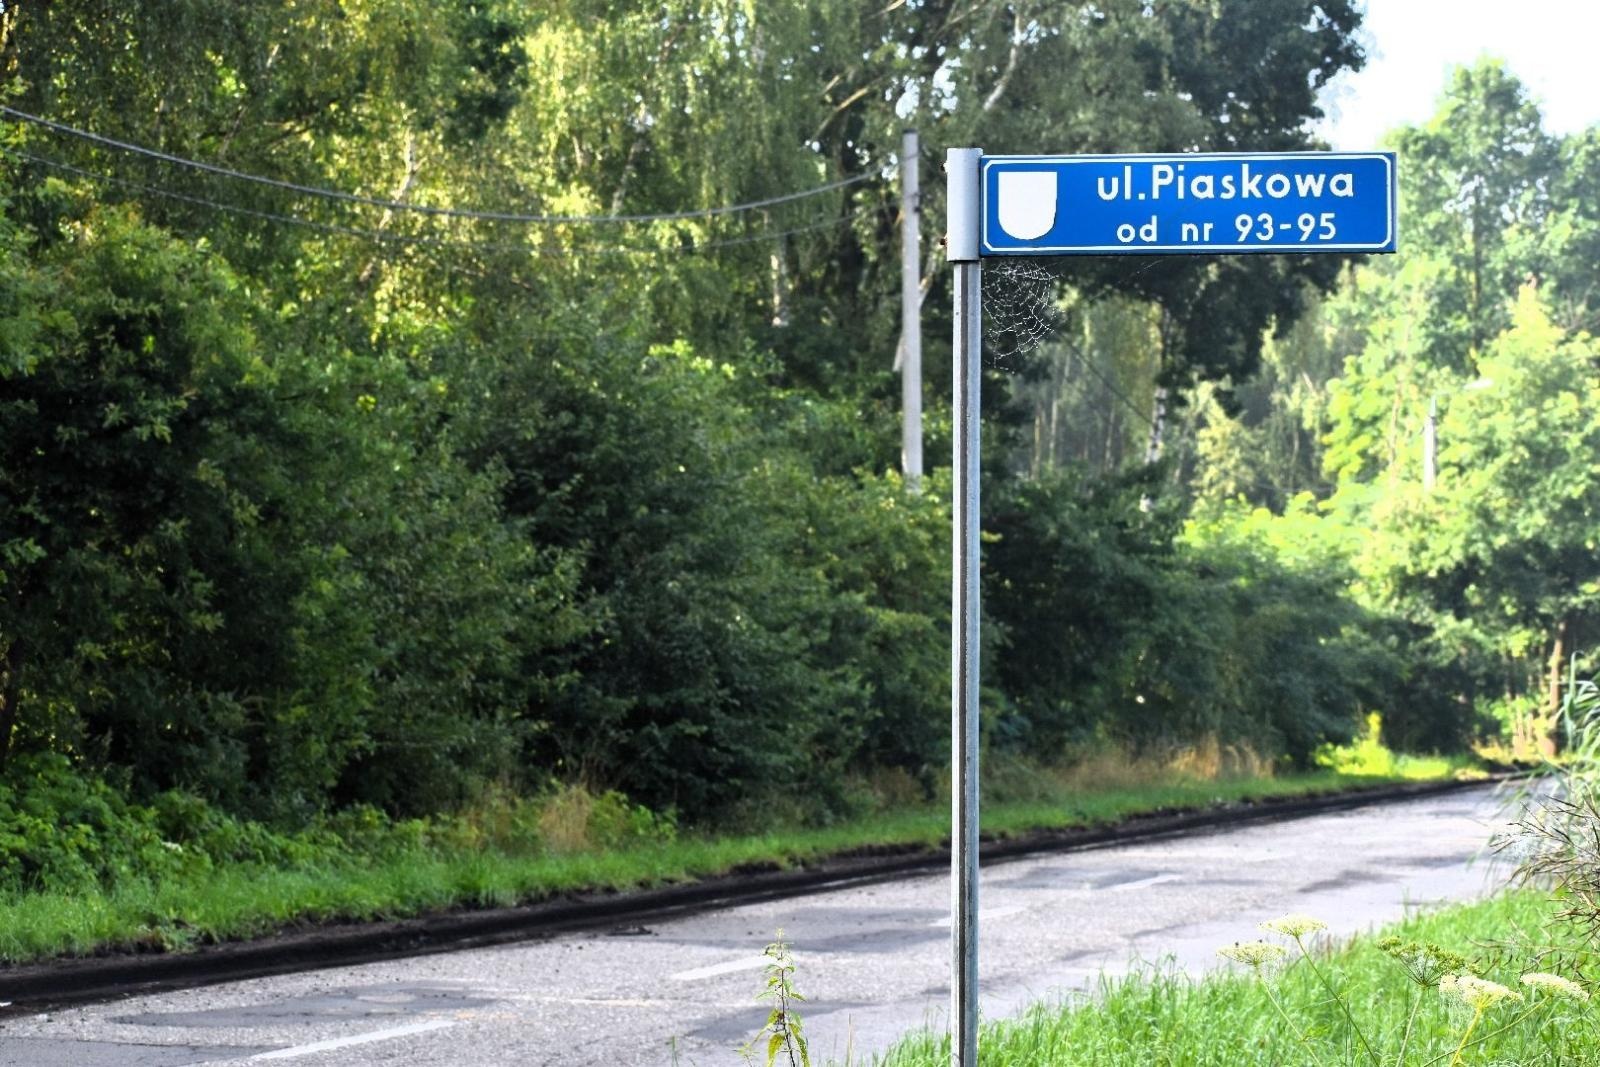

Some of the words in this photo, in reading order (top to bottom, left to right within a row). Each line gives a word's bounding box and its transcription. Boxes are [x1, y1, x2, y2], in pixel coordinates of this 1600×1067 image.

[1116, 215, 1158, 243] od
[1181, 222, 1213, 242] nr
[1236, 212, 1336, 242] 93-95
